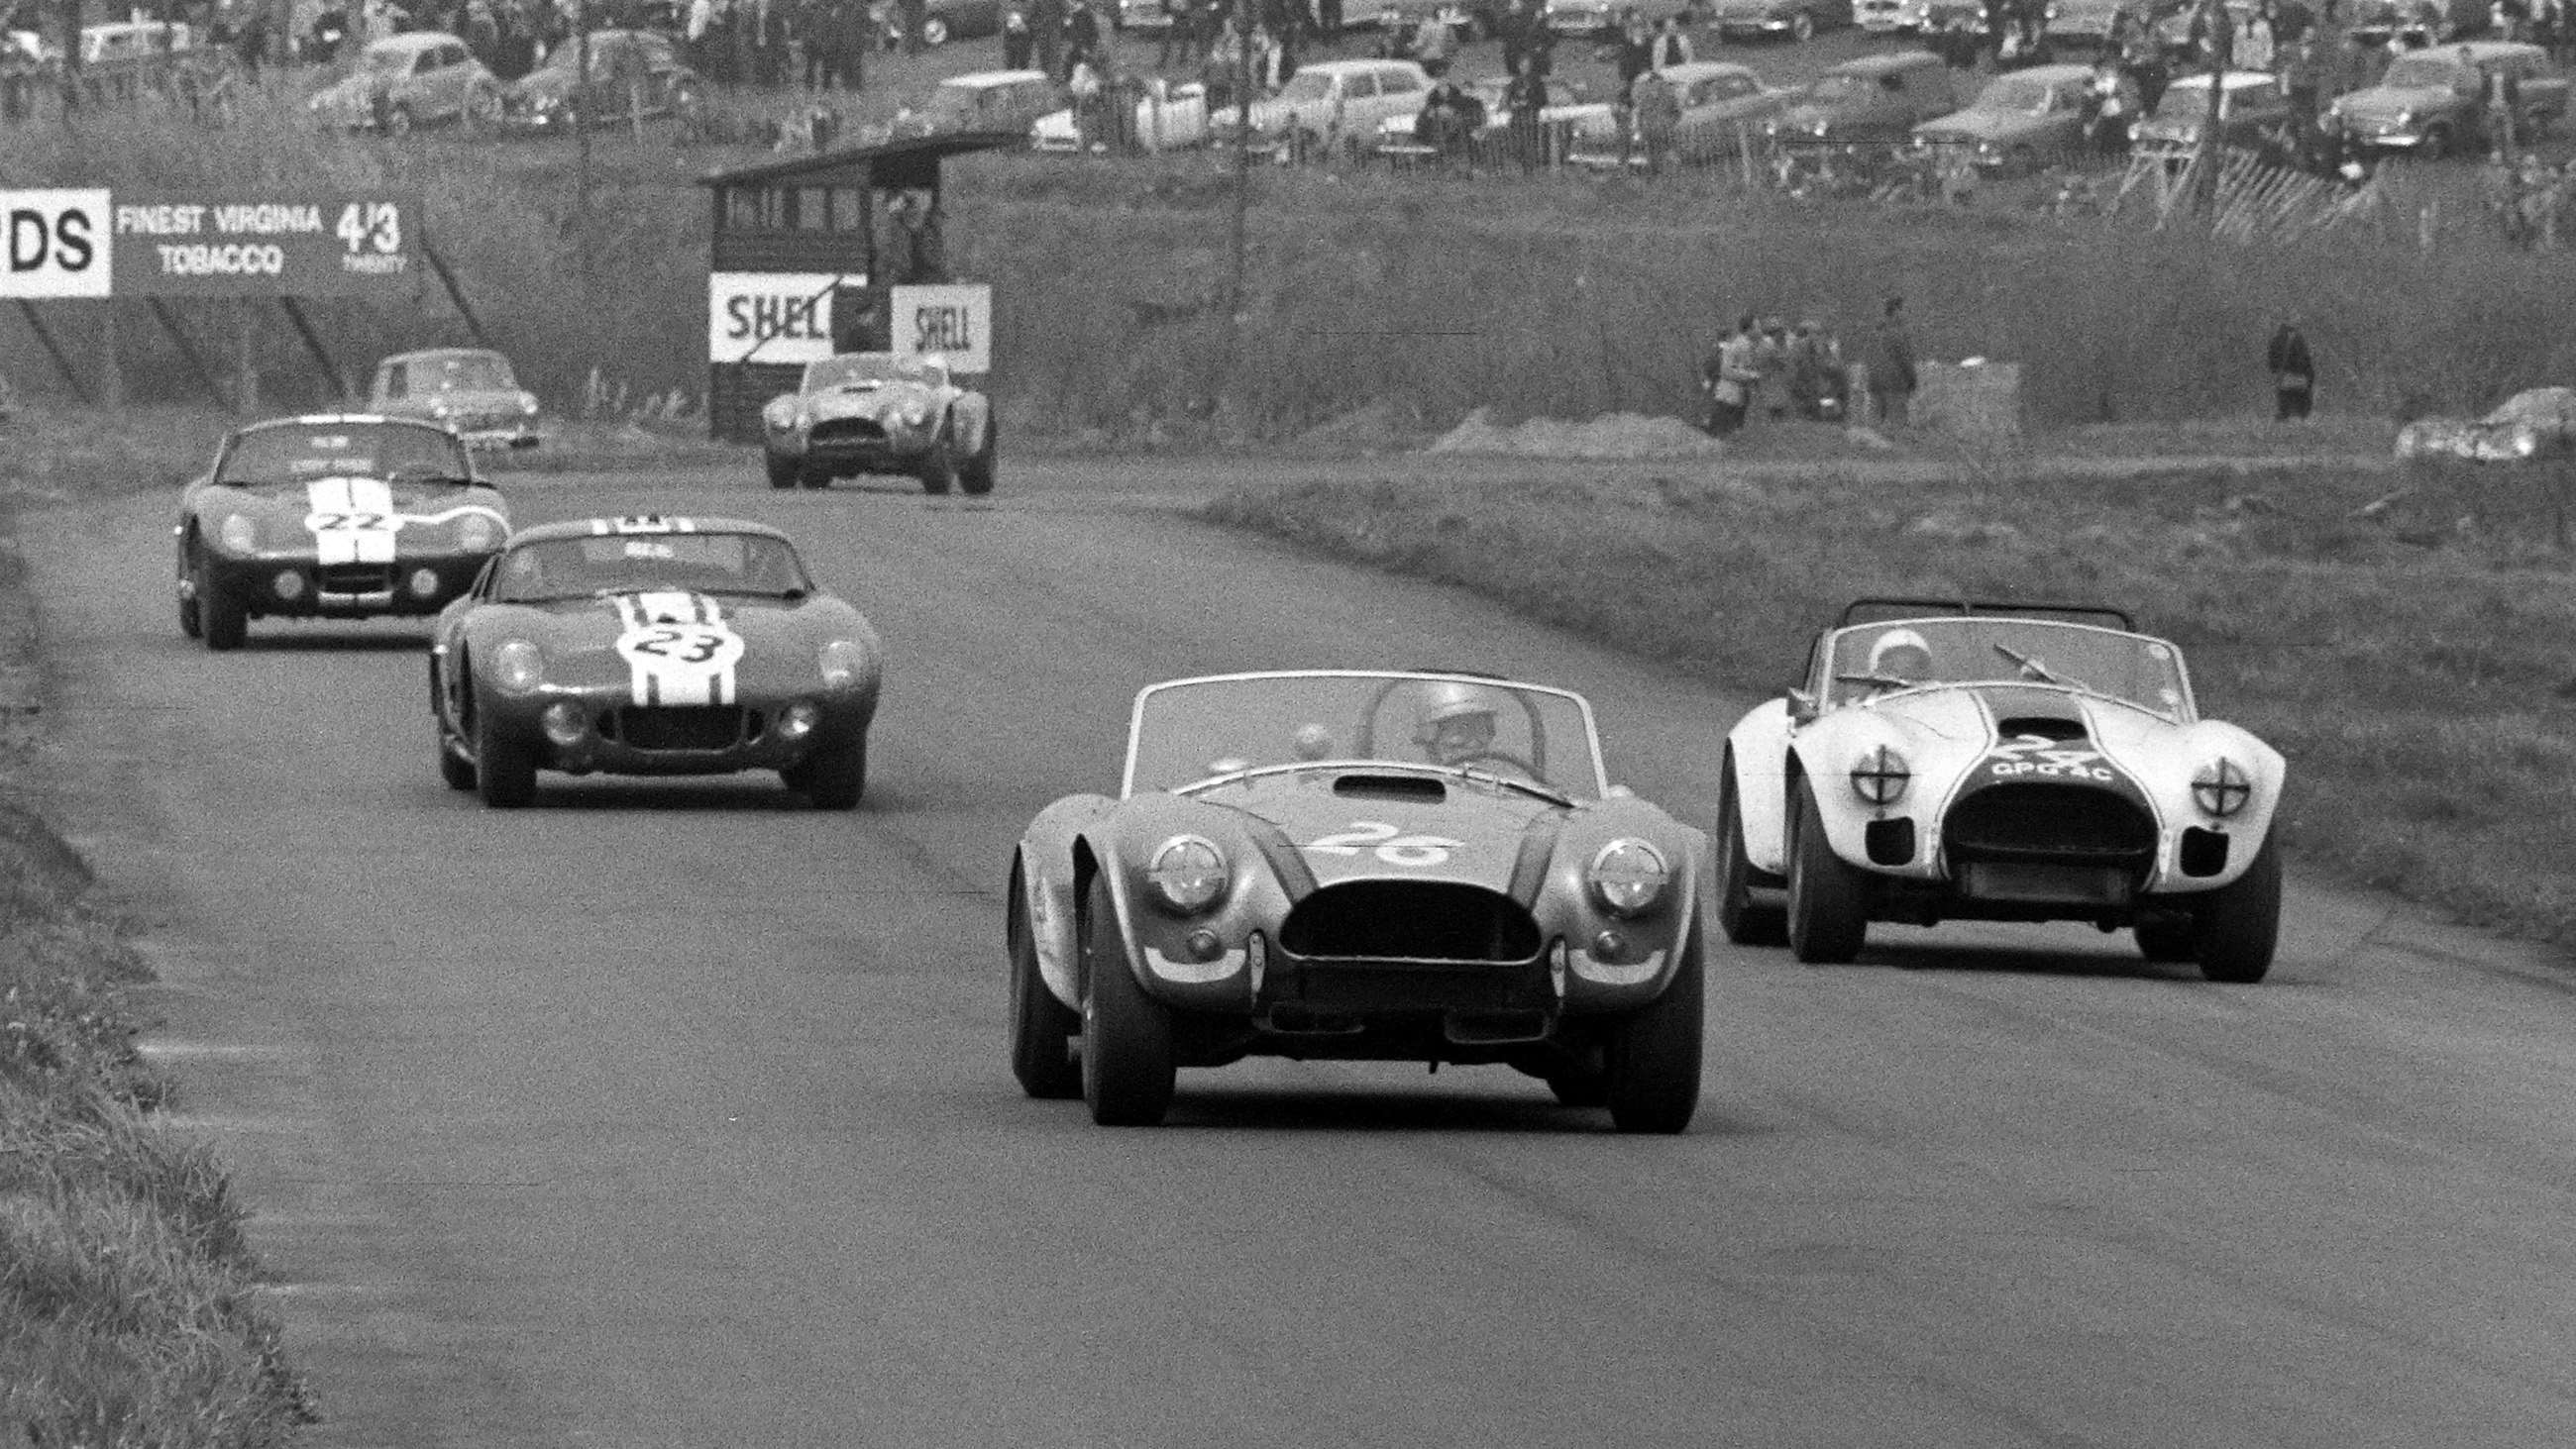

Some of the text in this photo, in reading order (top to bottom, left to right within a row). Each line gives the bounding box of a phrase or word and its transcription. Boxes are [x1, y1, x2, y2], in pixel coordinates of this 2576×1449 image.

[116, 204, 324, 234] FINEST VIRGINIA
[0, 208, 93, 272] DS
[157, 244, 284, 275] TOBACCO
[726, 294, 825, 339] SHEL
[318, 513, 388, 531] 22
[634, 630, 724, 663] 23
[1307, 821, 1465, 867] 26
